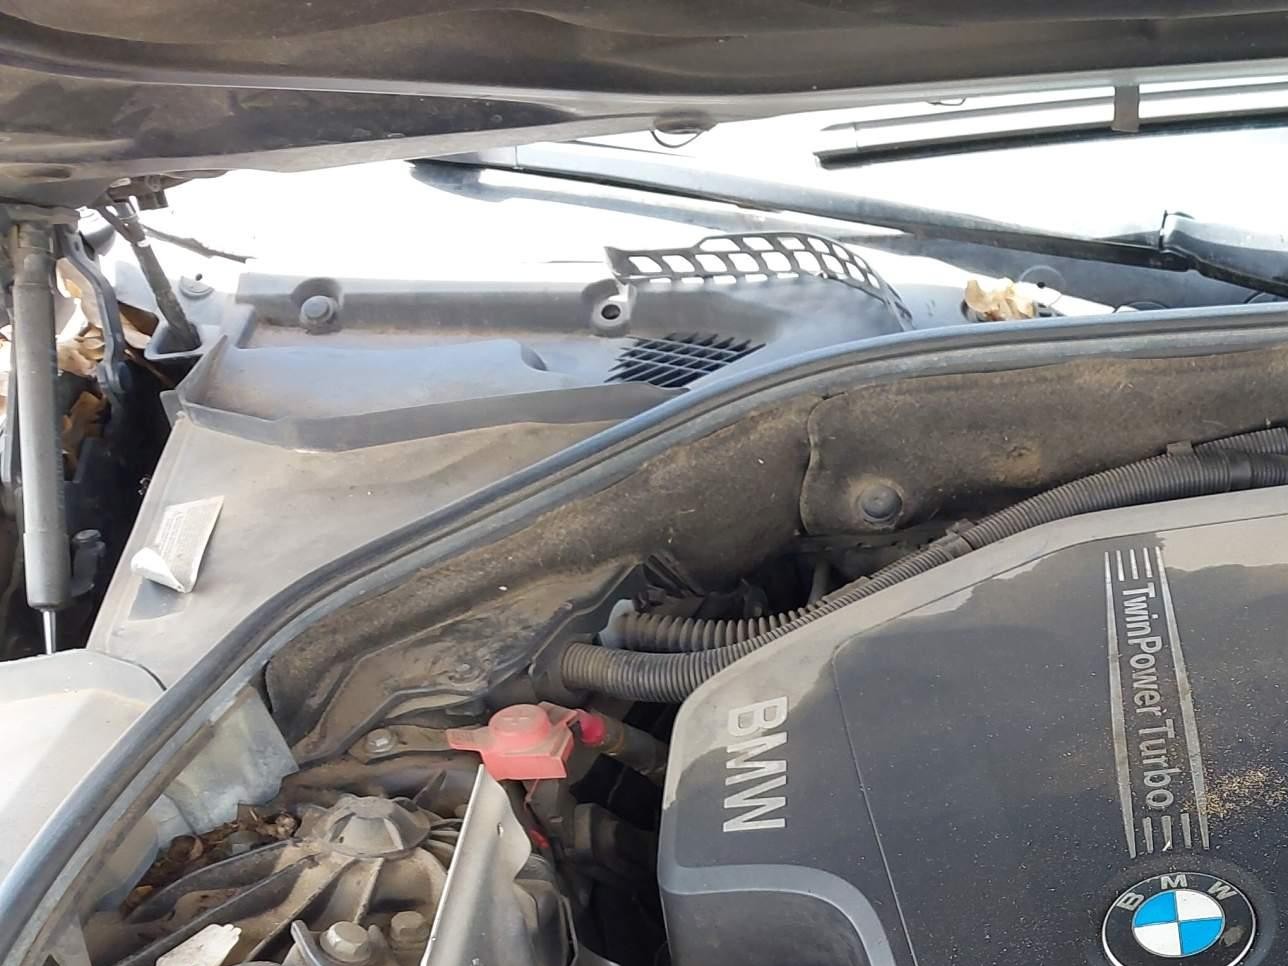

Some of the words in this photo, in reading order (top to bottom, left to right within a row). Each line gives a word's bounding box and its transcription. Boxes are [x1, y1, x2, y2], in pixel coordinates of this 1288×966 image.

[1122, 582, 1168, 714] TwinPower
[723, 696, 788, 832] BMW
[1138, 718, 1182, 807] Turbo
[1116, 874, 1237, 911] BMW
